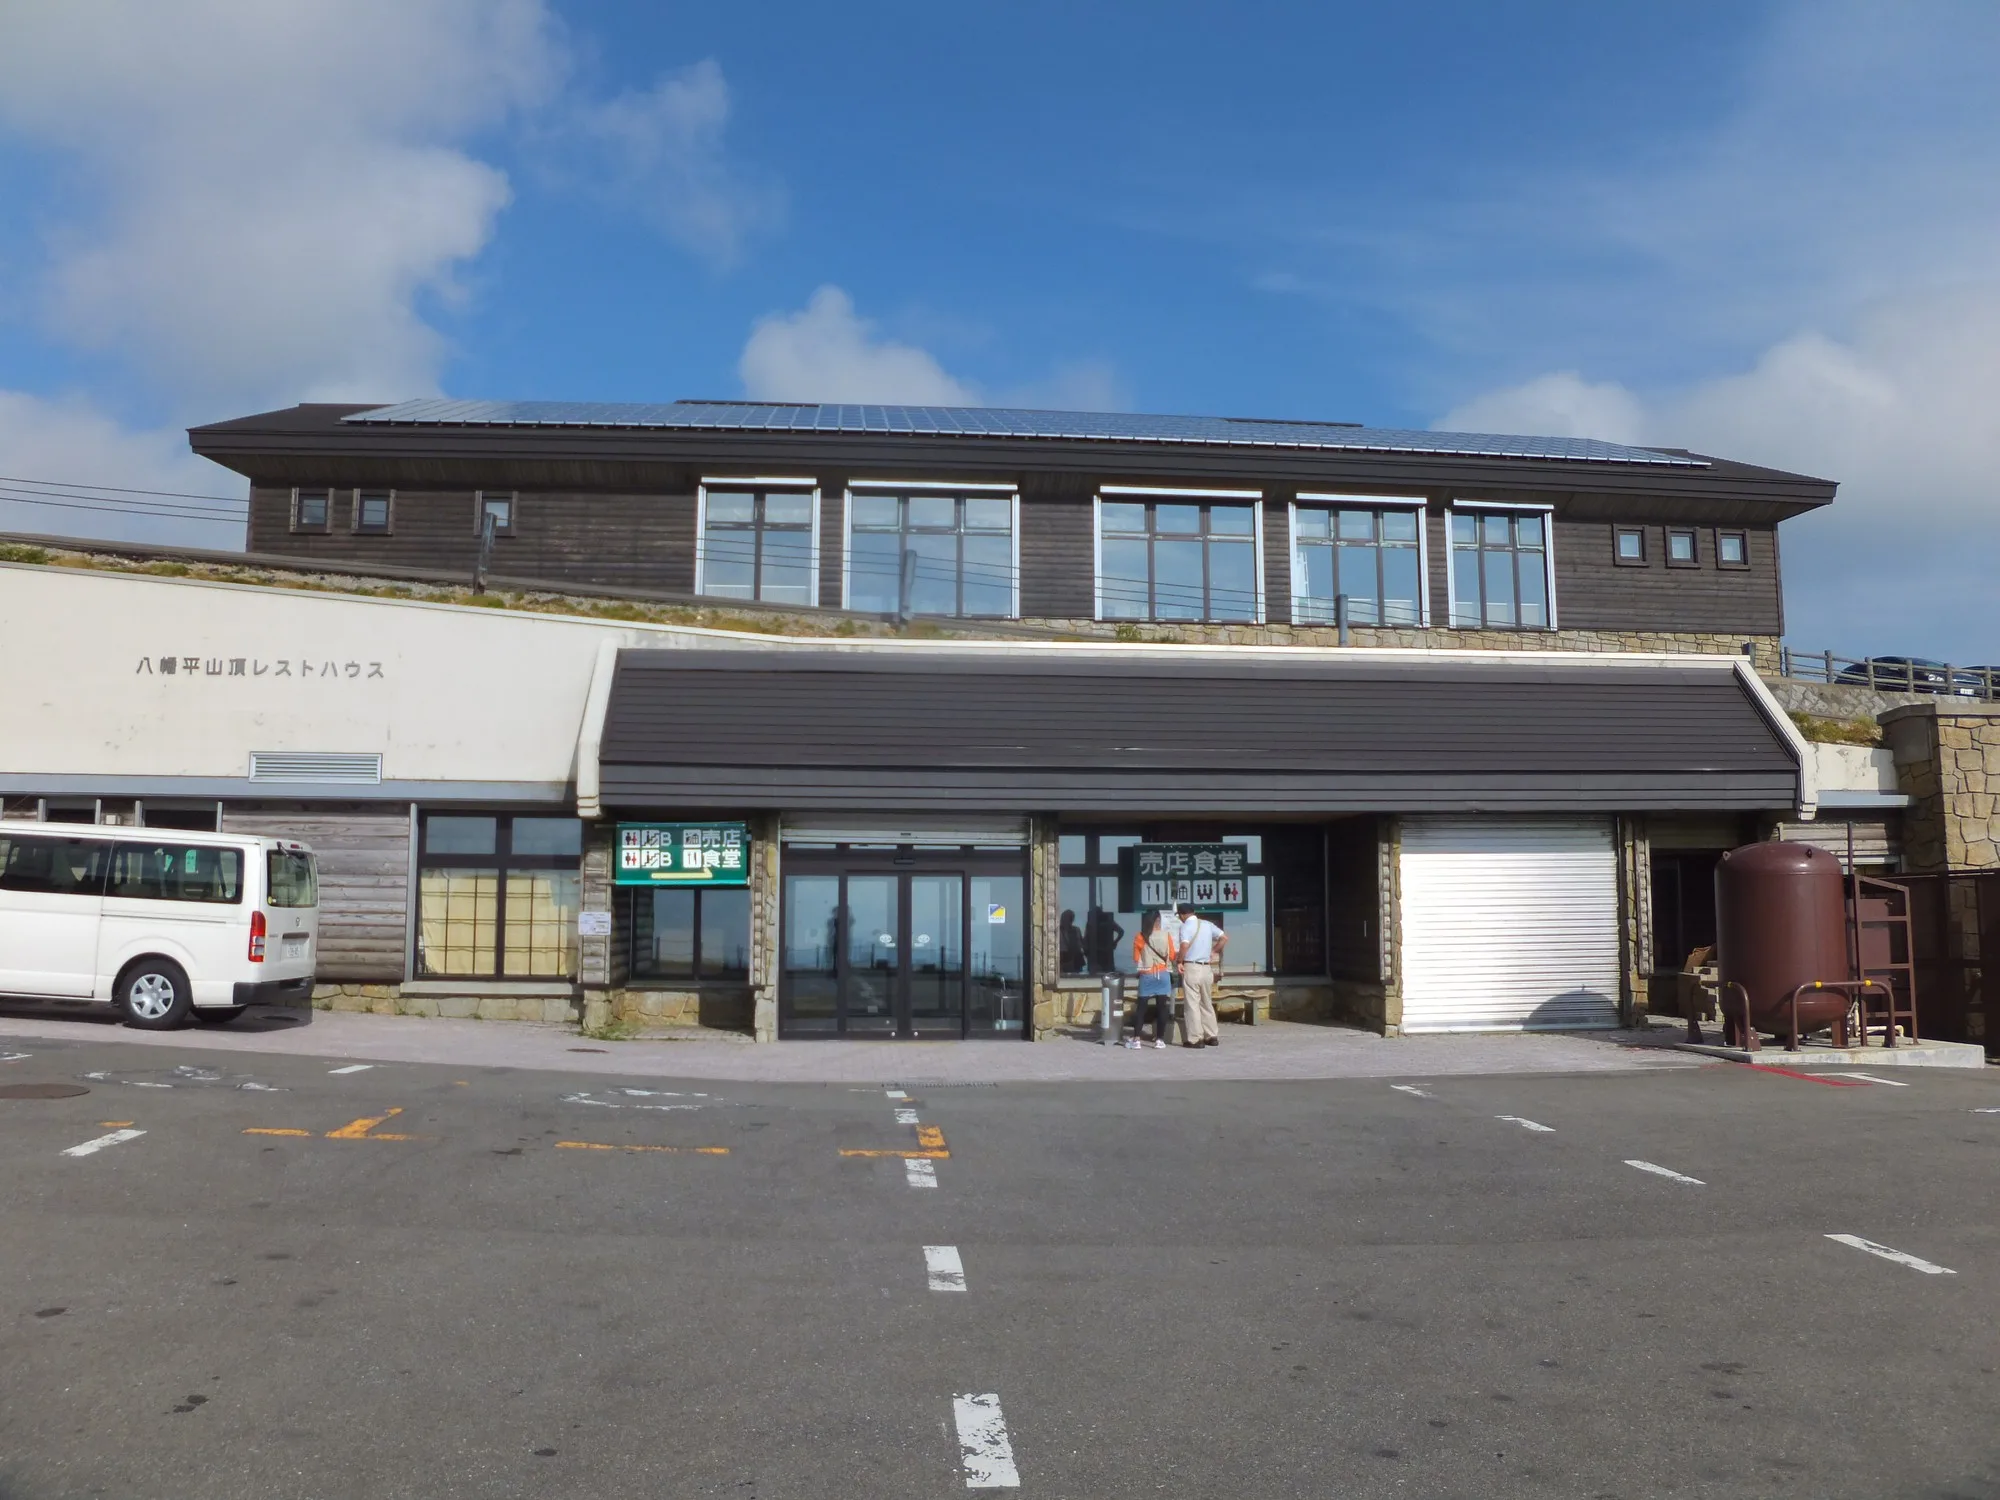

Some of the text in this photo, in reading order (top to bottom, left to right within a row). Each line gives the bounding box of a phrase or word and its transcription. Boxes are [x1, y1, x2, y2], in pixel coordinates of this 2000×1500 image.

[136, 656, 385, 679] 八幡平山頂レストハウス
[702, 829, 741, 848] 売店
[702, 849, 742, 868] 食堂
